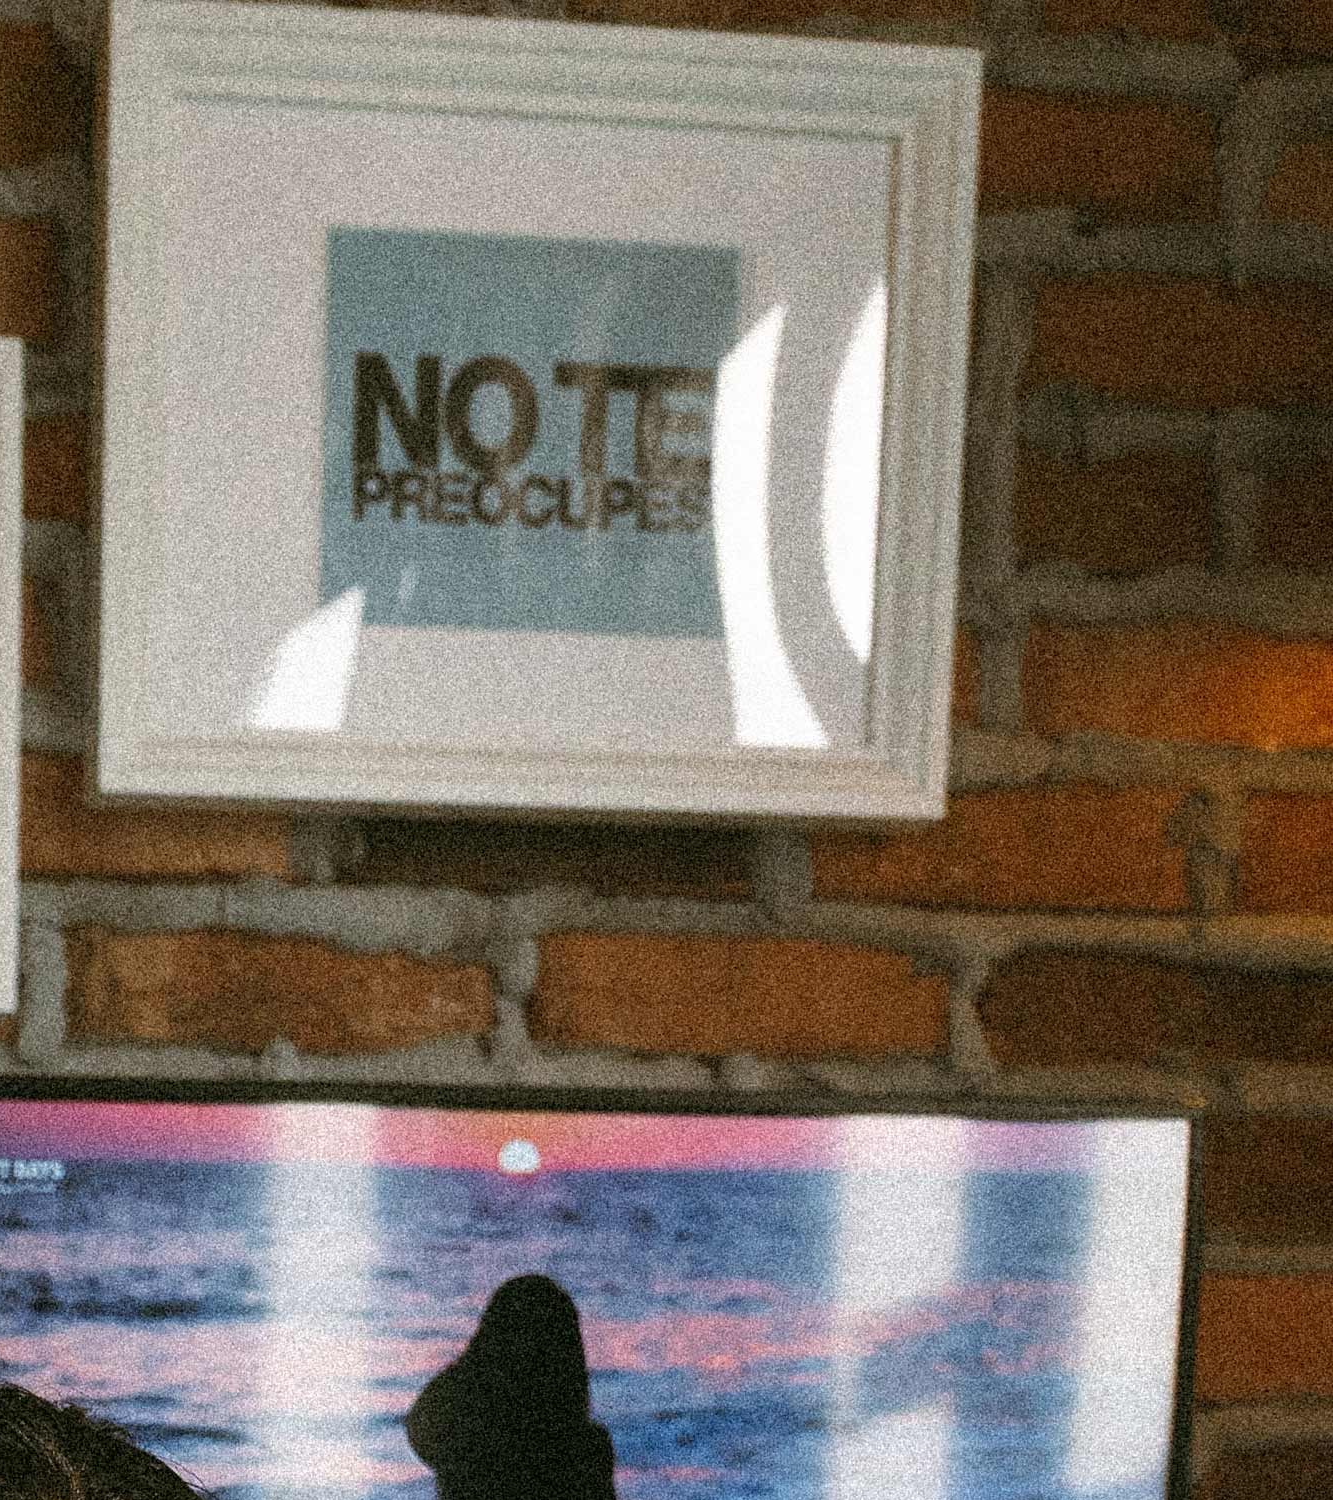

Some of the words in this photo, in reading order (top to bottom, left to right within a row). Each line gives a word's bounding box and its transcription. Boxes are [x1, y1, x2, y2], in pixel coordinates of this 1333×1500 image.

[353, 352, 539, 477] NO
[553, 362, 717, 481] TE
[352, 470, 714, 533] PREOCUPES
[14, 1159, 65, 1180] DAYS
